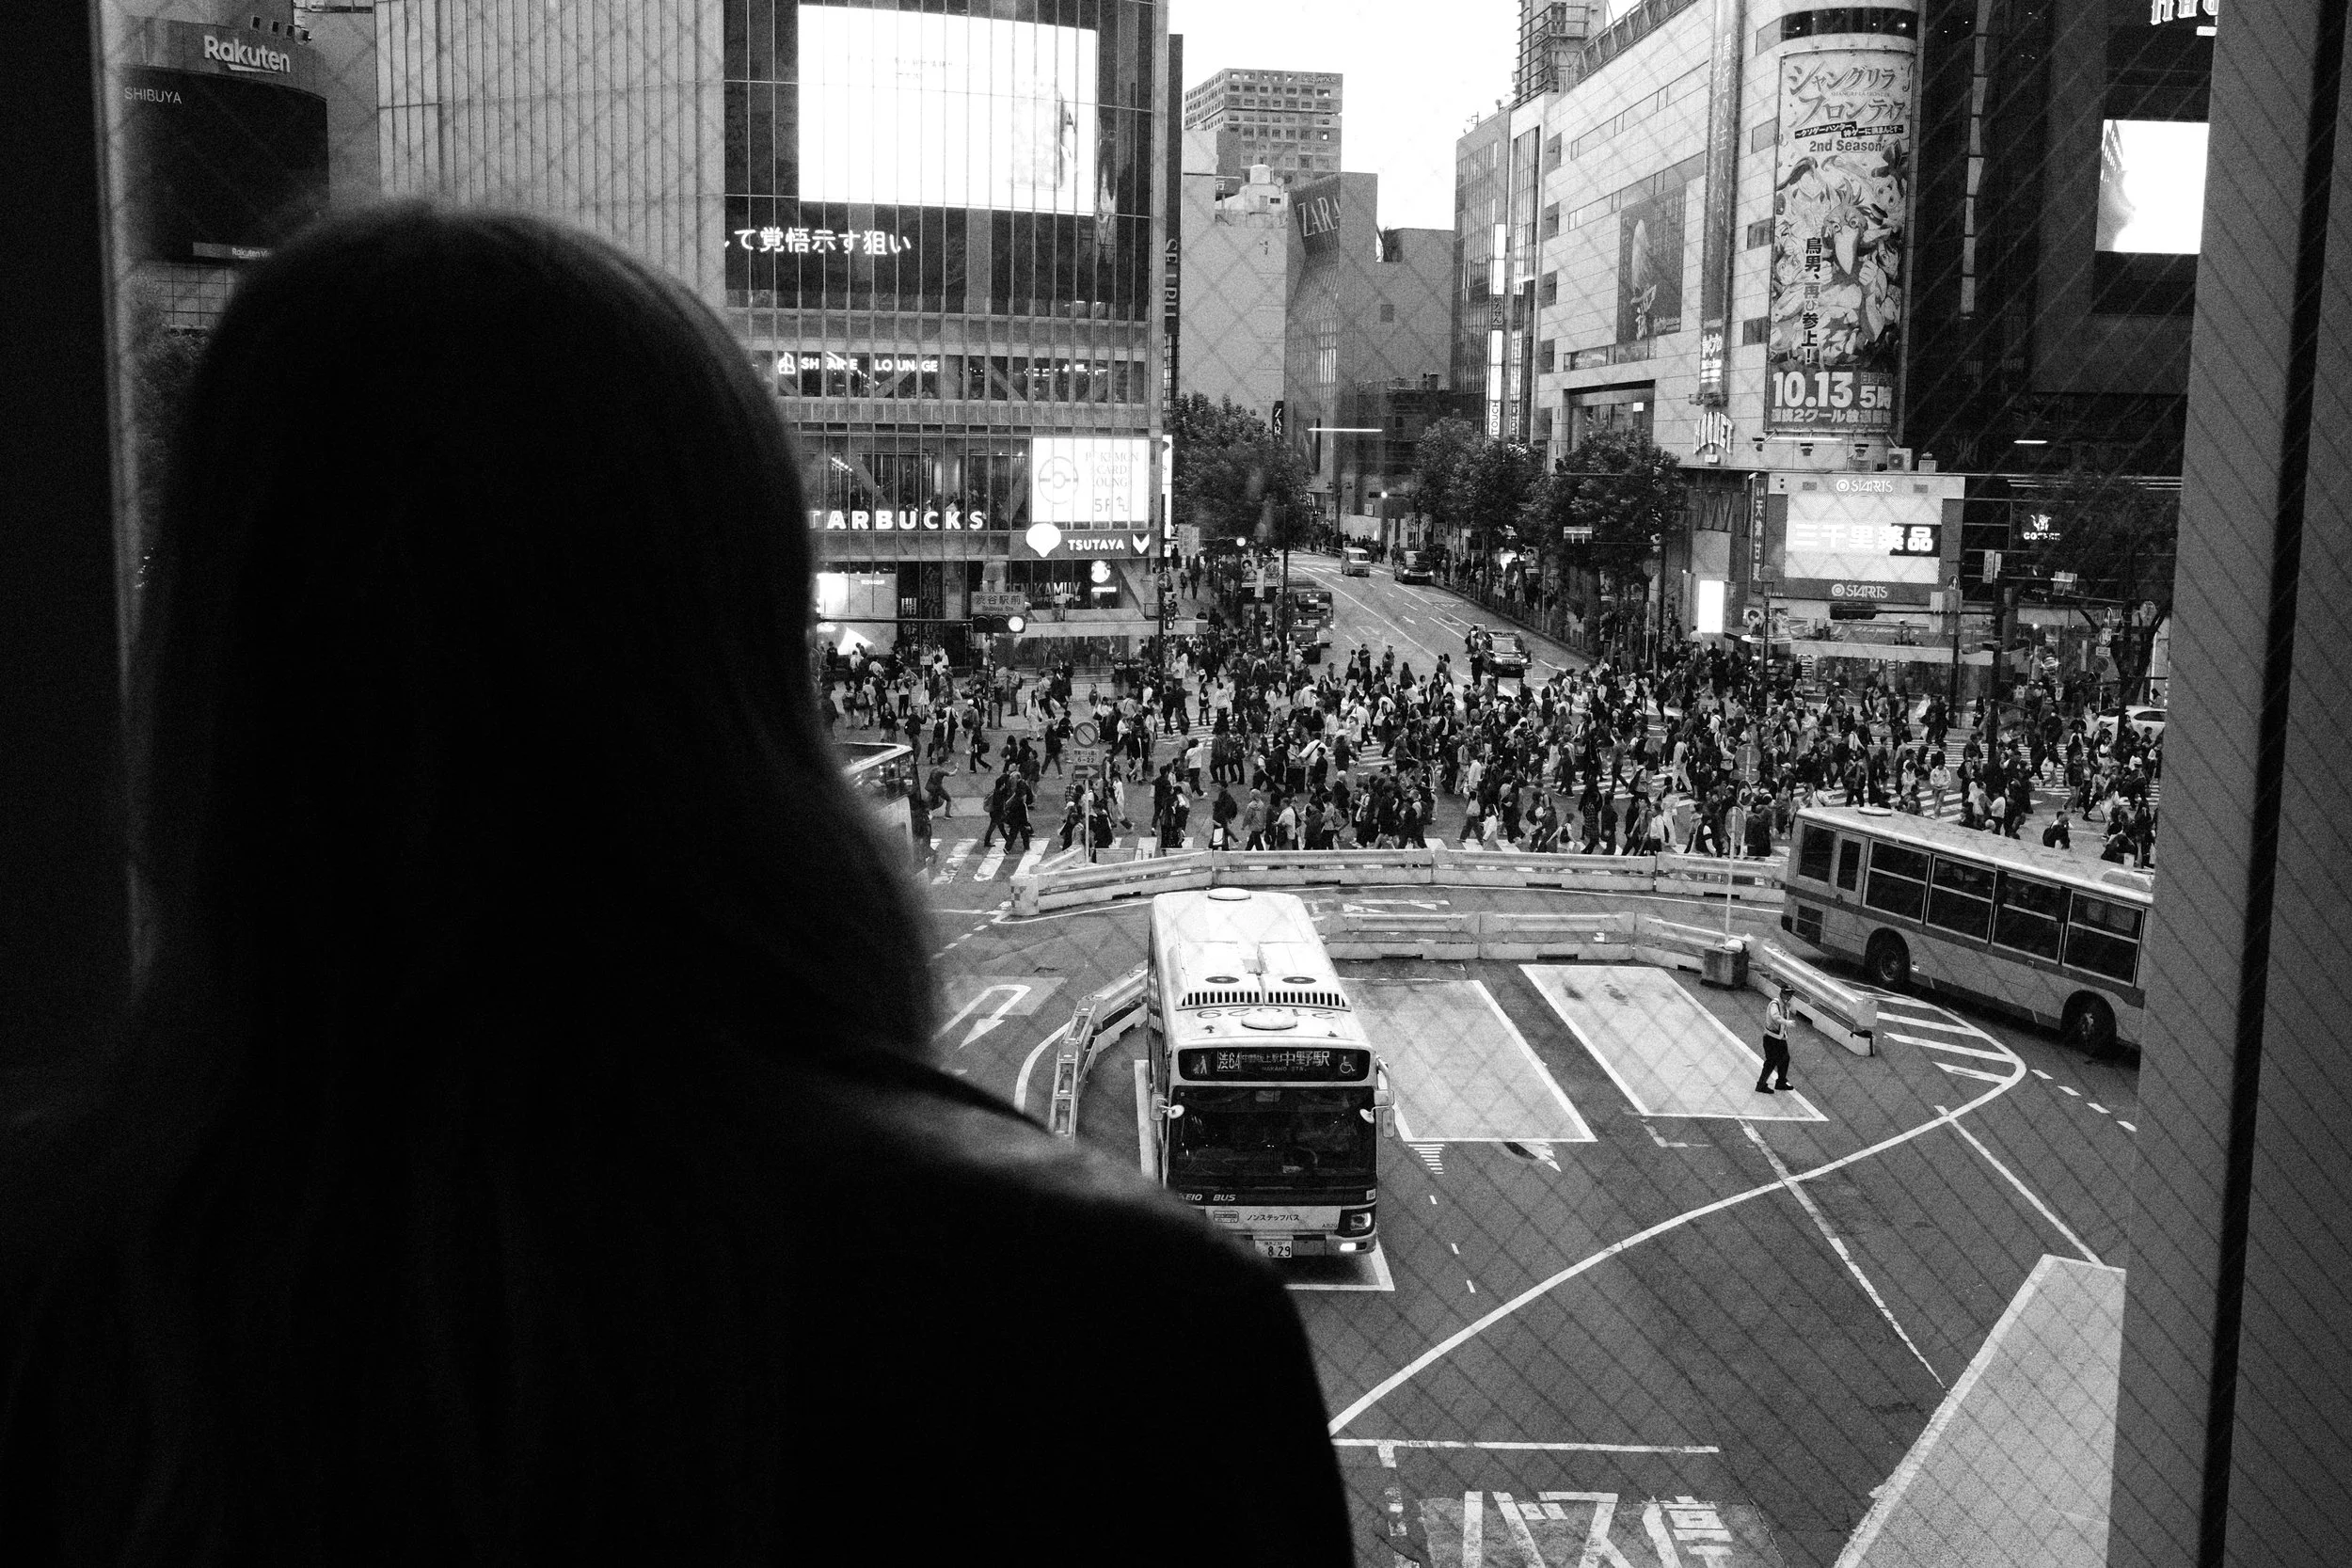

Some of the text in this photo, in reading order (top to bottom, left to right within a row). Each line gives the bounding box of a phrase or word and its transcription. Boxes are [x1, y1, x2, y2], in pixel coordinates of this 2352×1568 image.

[204, 35, 291, 73] Rakuten
[1788, 61, 1897, 95] シャングリラ
[124, 87, 183, 104] SHIBUYA
[1788, 94, 1906, 128] フロンティア
[1809, 139, 1882, 152] 2nd Season
[724, 227, 912, 255] て覚悟示す狙い
[874, 358, 938, 372] LOUNGE
[1772, 371, 1853, 408] 10.13
[1093, 477, 1128, 487] OUNG
[1068, 539, 1125, 551] TSUTAYA
[1793, 524, 1933, 552] 三千里薬品
[976, 594, 1021, 606] 渋谷駅前
[1217, 1051, 1241, 1070] 渋64
[1279, 1050, 1330, 1067] 中野駅
[1213, 1194, 1237, 1202] BUS
[1247, 1213, 1300, 1222] ノンステップバス
